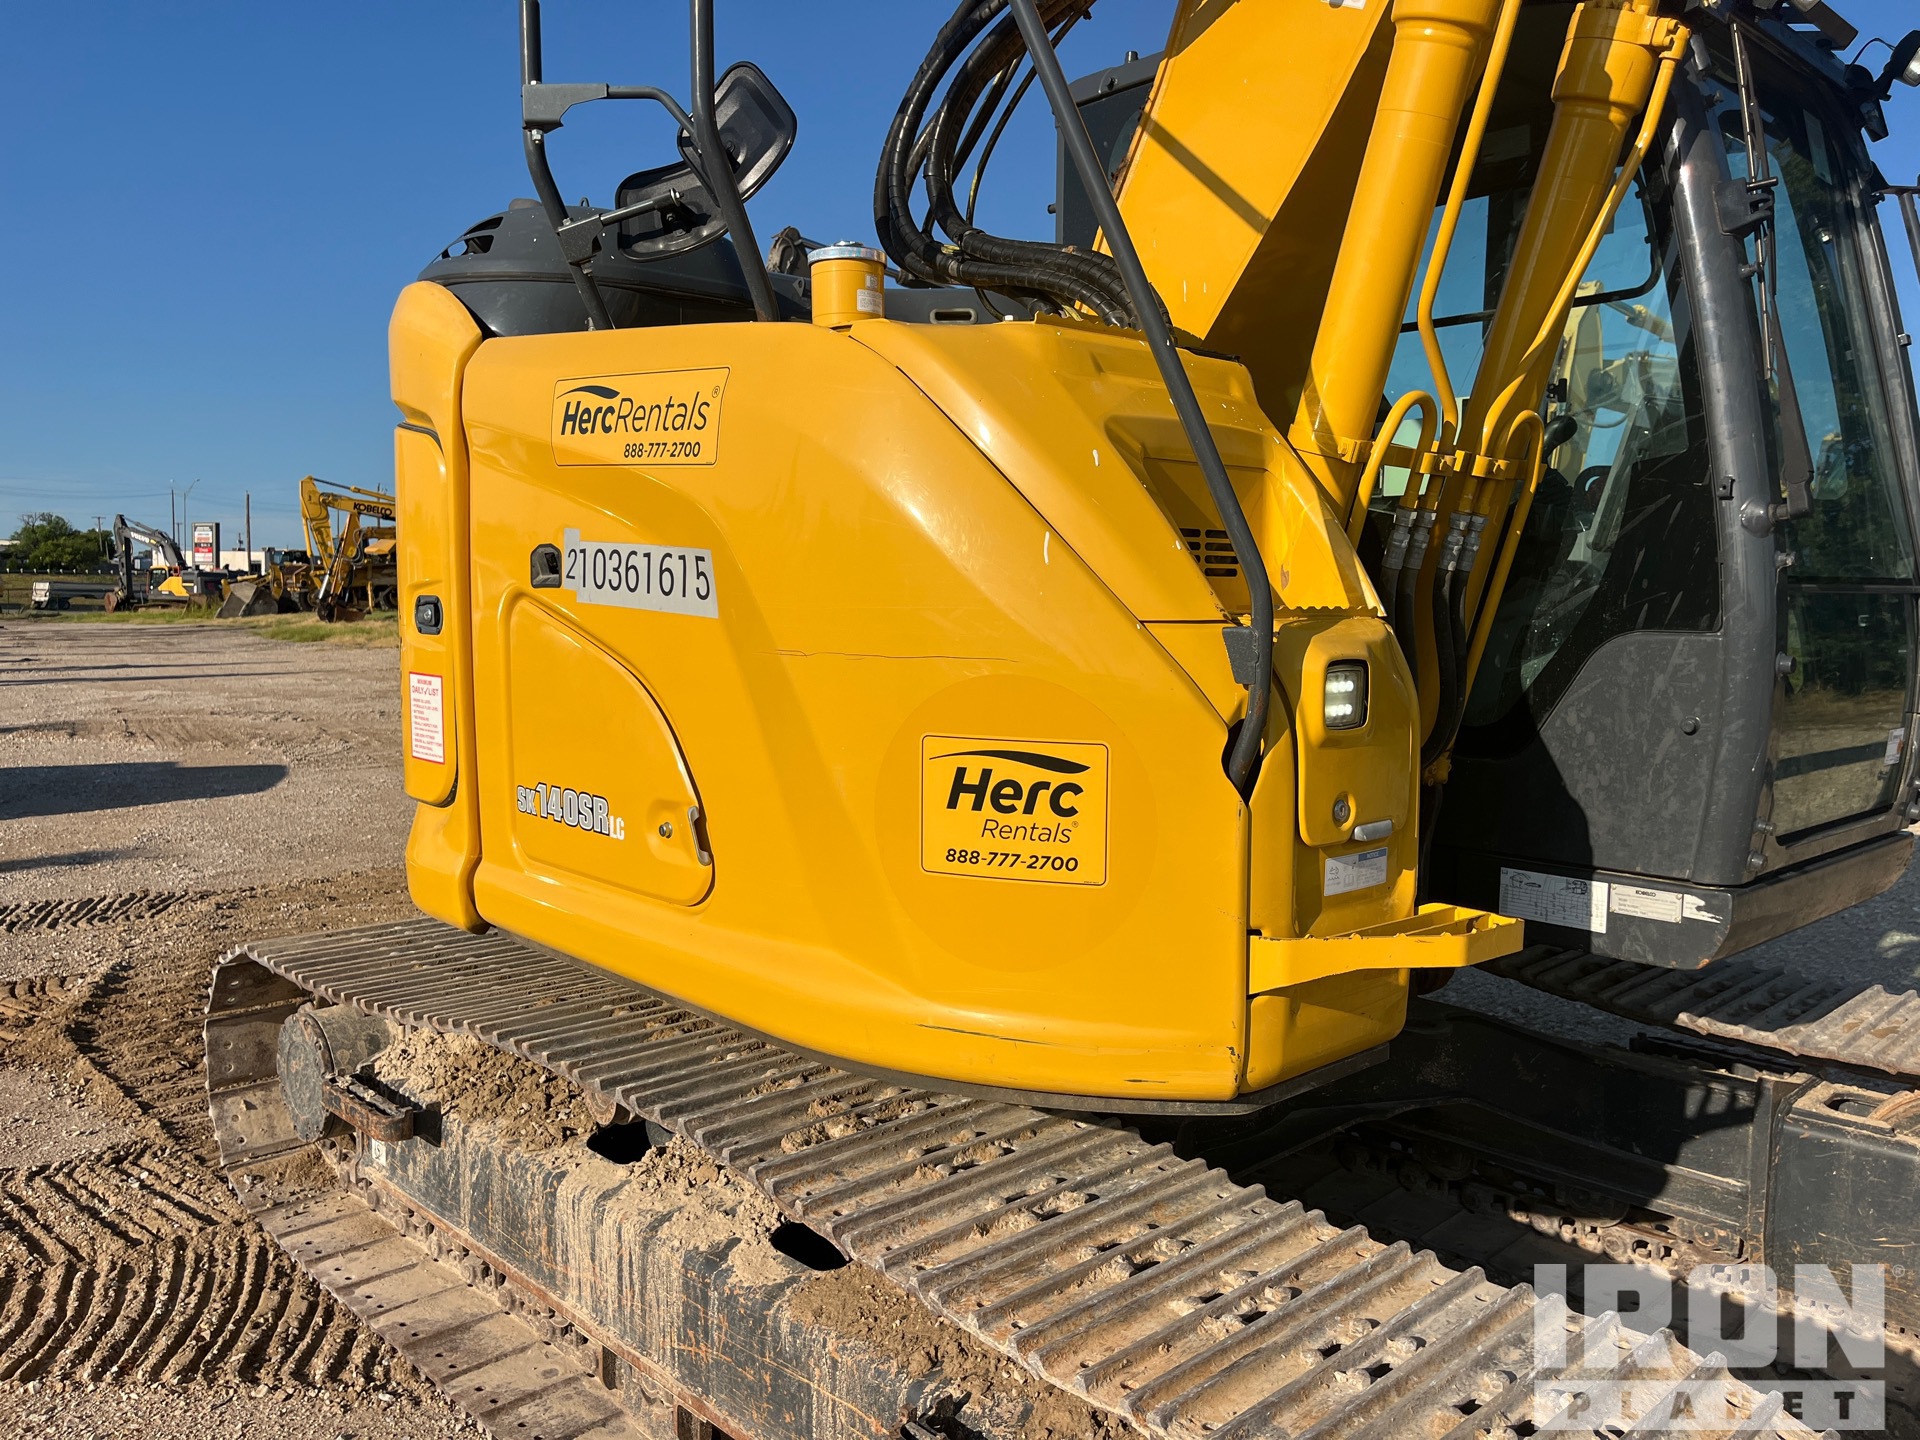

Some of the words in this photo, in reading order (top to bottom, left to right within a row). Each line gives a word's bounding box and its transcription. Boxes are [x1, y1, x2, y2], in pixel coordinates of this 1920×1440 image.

[623, 441, 701, 458] 888-777-2700
[353, 501, 393, 517] KOBELCO
[131, 531, 150, 544] VOLVO
[565, 548, 710, 600] 210361615
[946, 766, 1084, 818] Herc
[981, 818, 1073, 843] Rentals
[945, 848, 1079, 872] 888-777-2700
